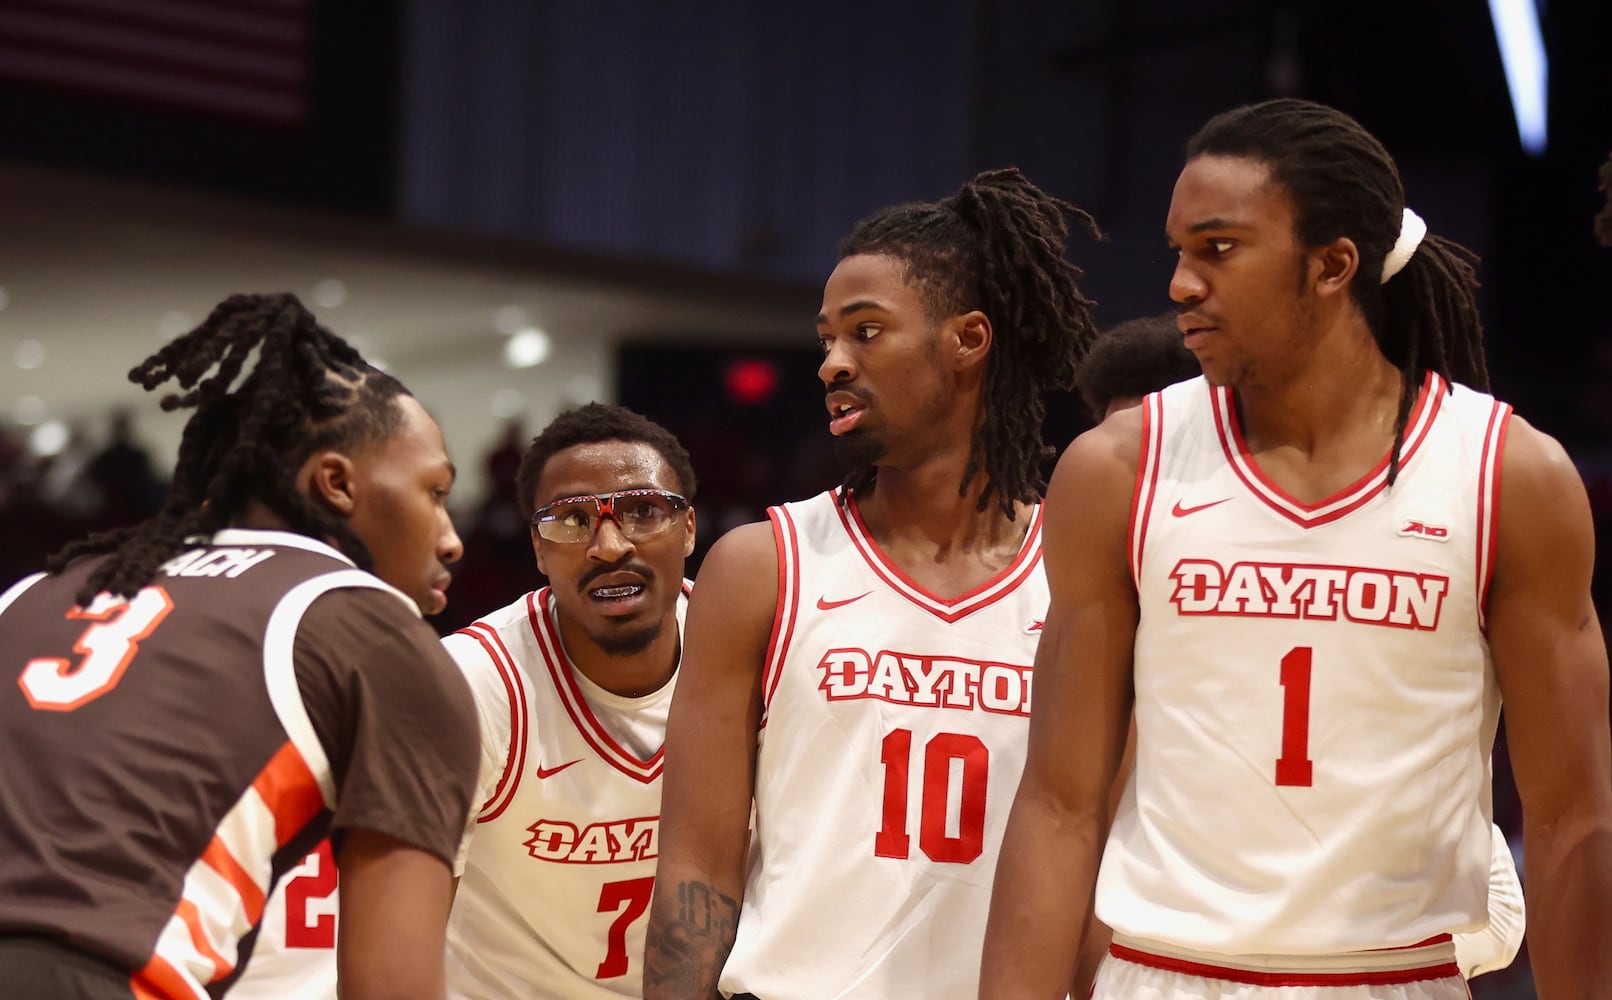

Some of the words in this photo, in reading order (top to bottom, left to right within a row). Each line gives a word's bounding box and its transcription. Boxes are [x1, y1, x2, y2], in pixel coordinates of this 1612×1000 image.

[17, 584, 175, 712] 3
[1169, 559, 1449, 632] DAYTON
[1275, 646, 1313, 787] 1
[874, 728, 989, 864] 10
[285, 837, 338, 949] 2
[595, 876, 656, 980] 7
